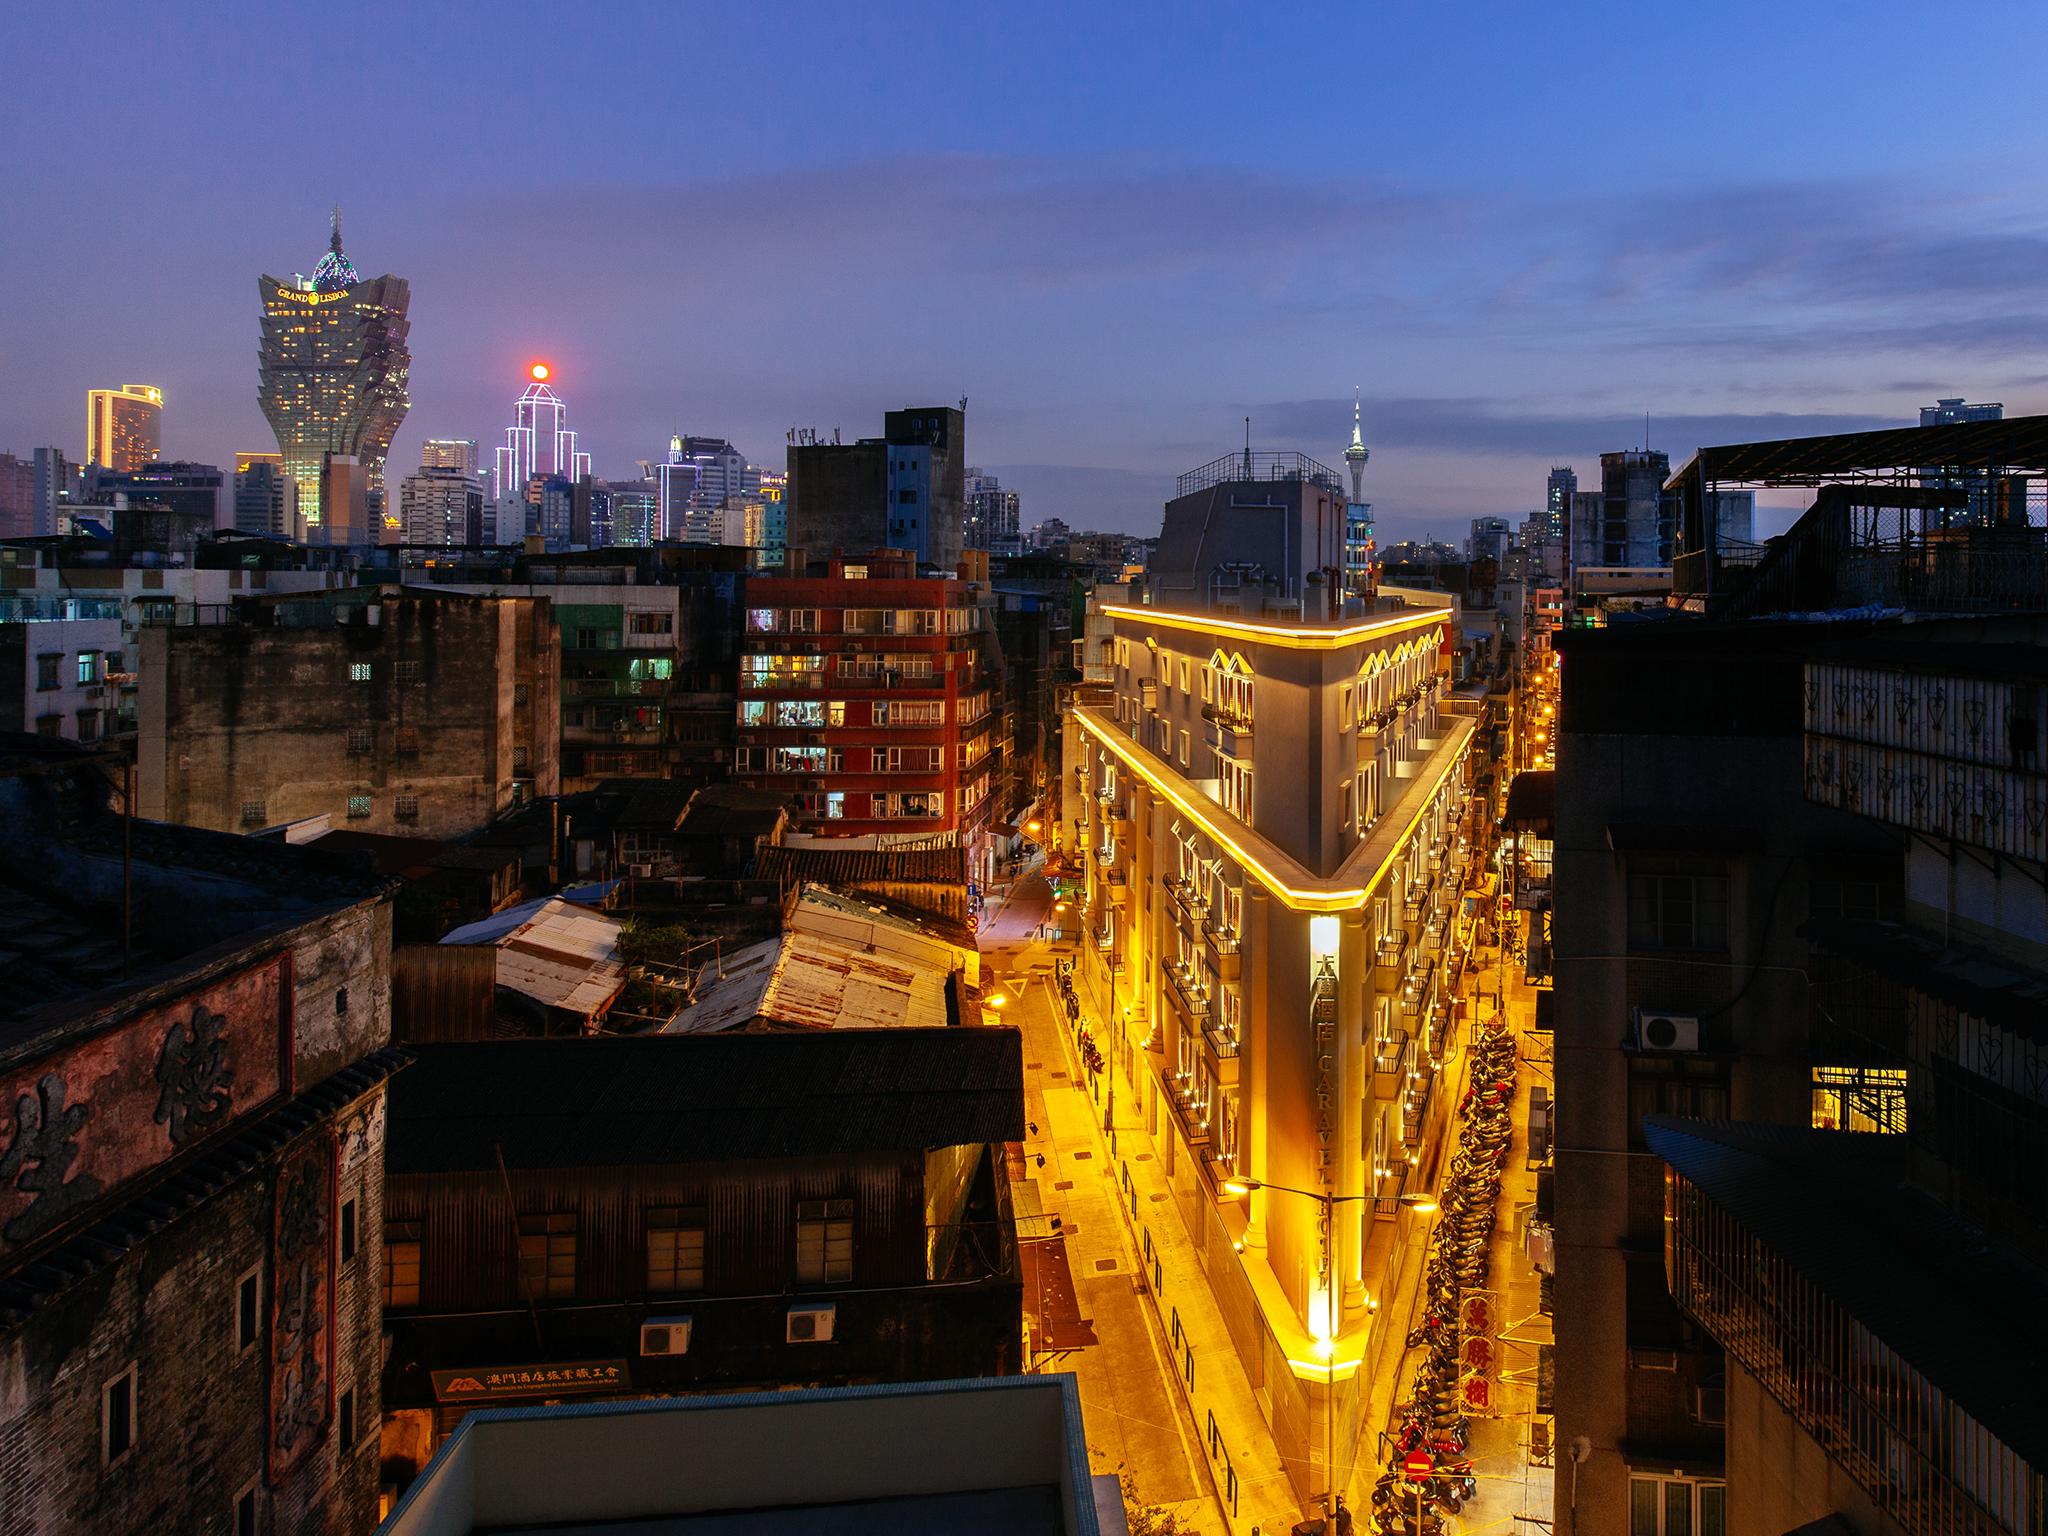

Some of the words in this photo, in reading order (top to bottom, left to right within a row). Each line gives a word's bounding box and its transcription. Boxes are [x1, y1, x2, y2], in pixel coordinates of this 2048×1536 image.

[277, 288, 308, 303] GRAND
[319, 290, 349, 302] LISBOA
[1317, 1055, 1335, 1185] CARAVEL
